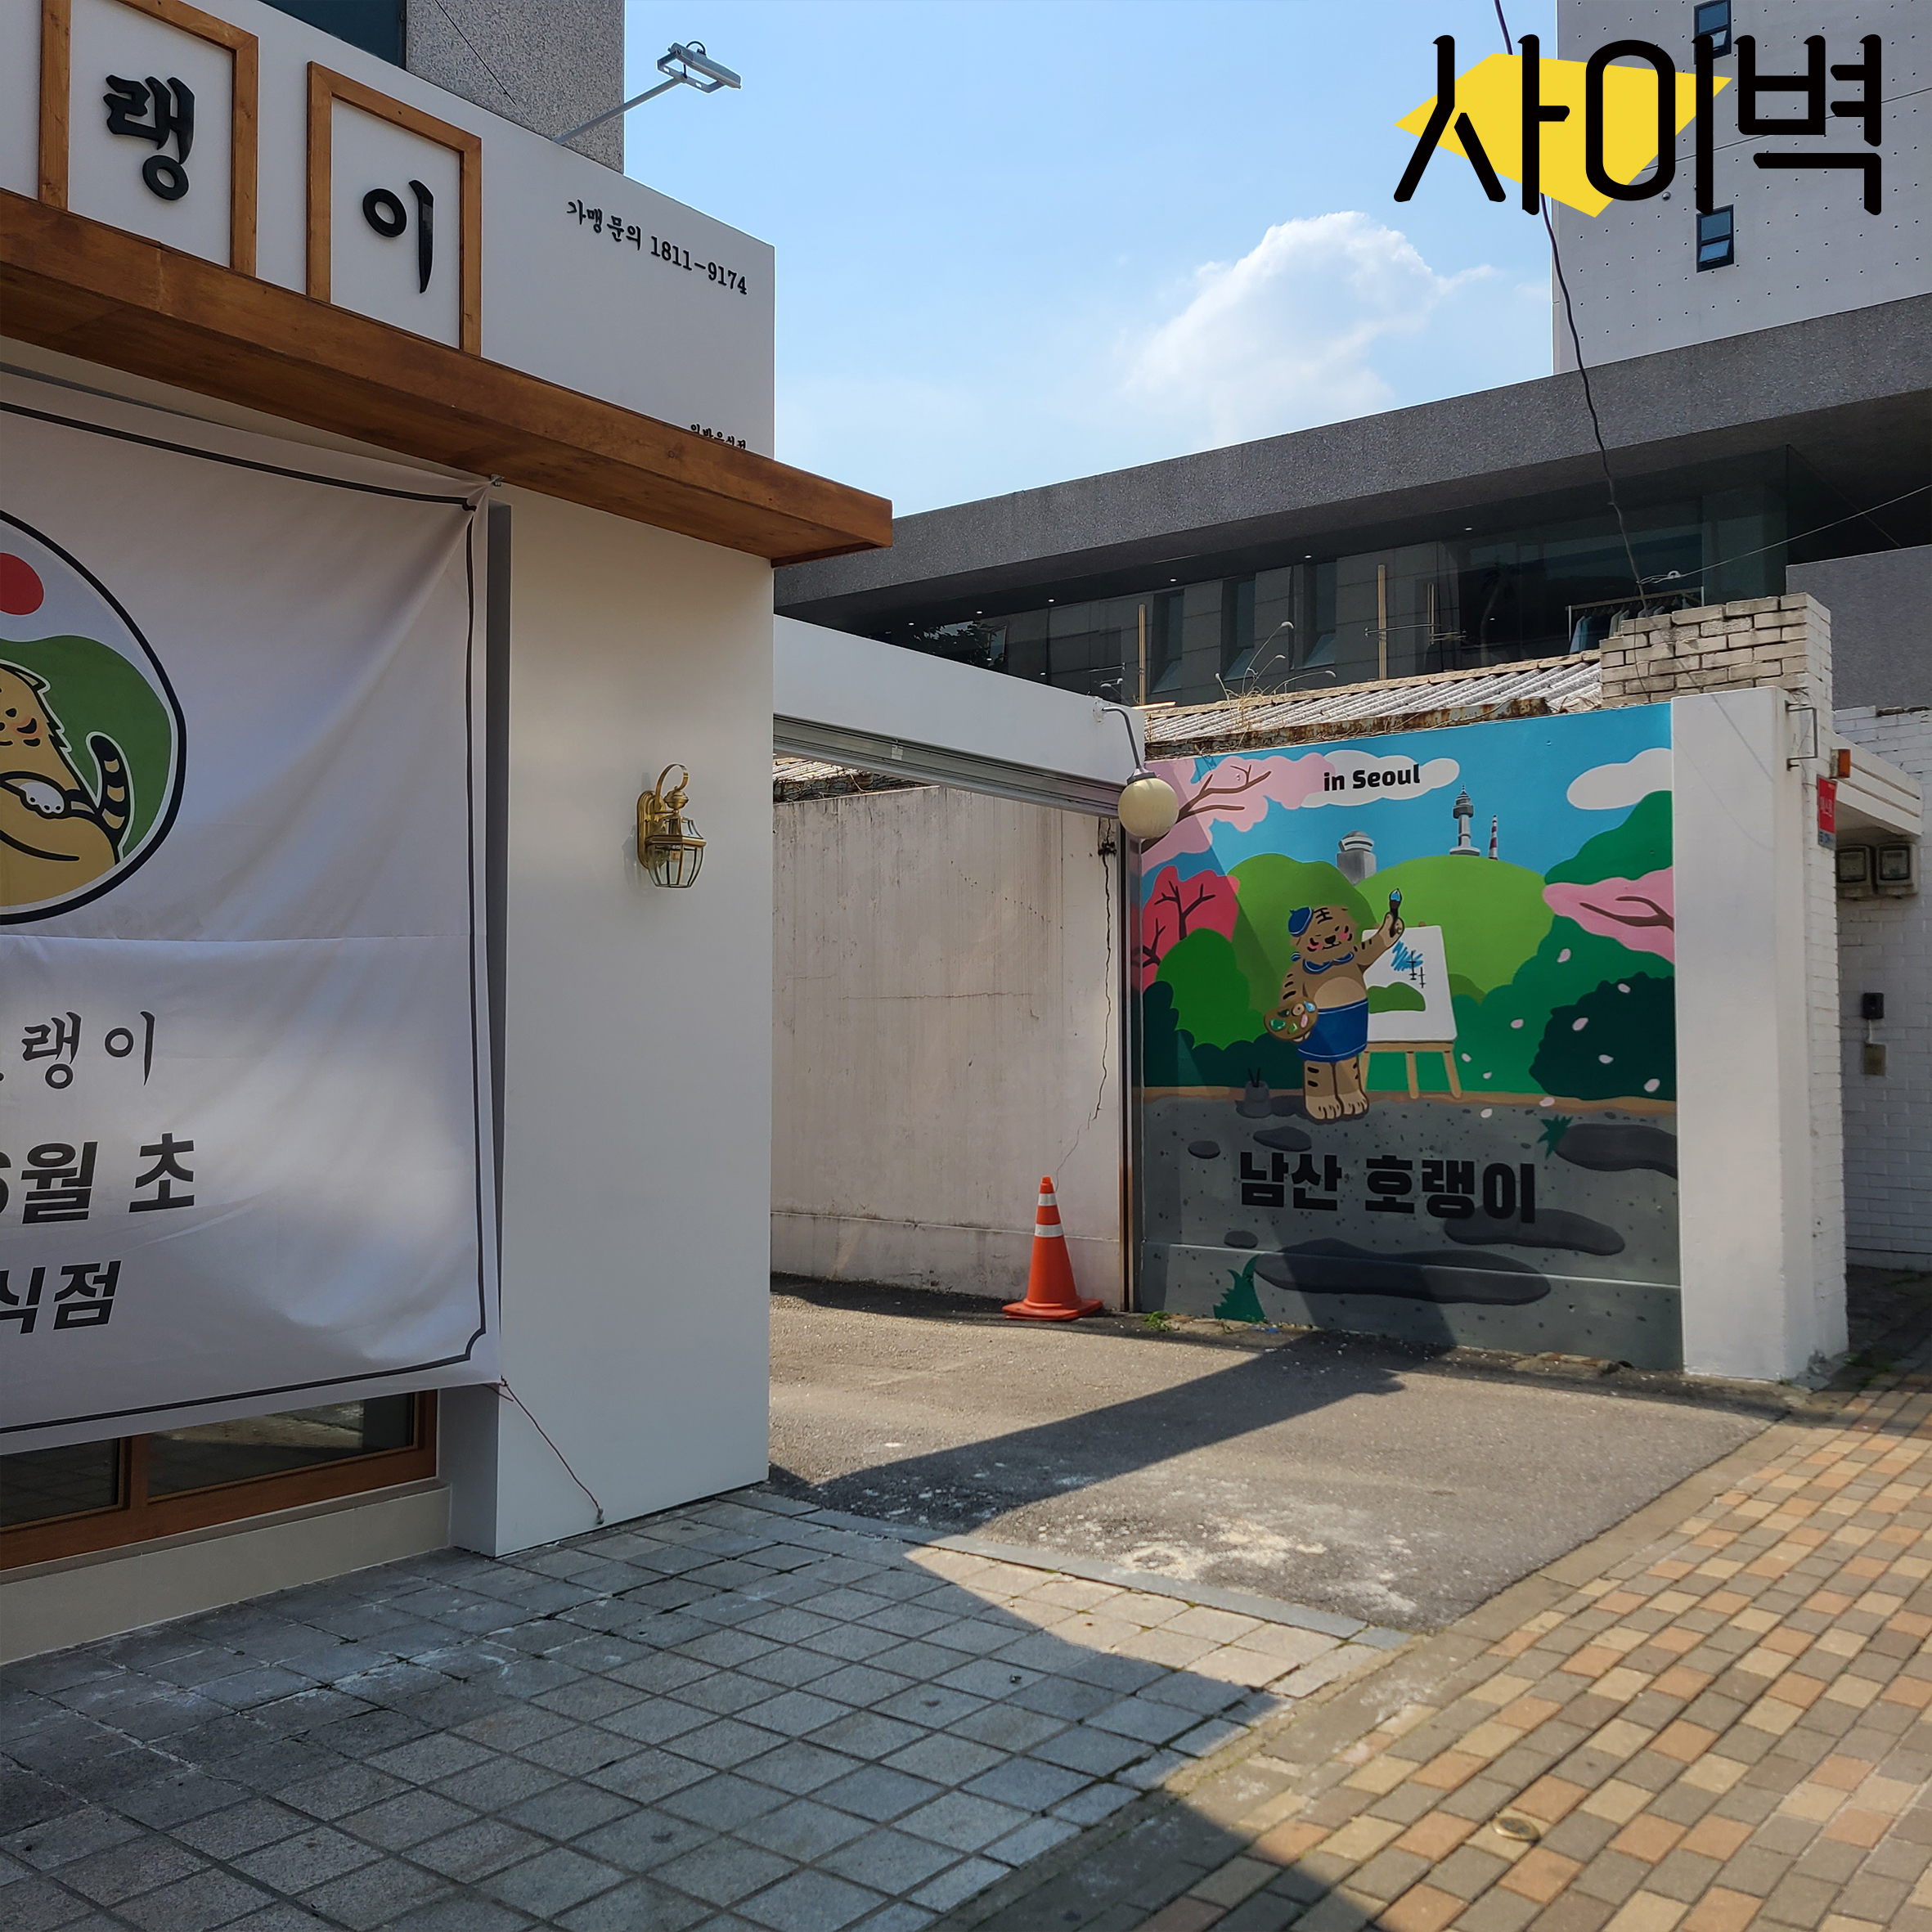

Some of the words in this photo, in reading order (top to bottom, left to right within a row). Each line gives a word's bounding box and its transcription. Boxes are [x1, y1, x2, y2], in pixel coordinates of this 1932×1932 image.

[567, 200, 603, 233] 가맹
[607, 215, 641, 250] 문의
[651, 236, 748, 295] 1811-9174
[1323, 771, 1345, 792] in
[1352, 763, 1420, 789] Seoul
[0, 1011, 155, 1090] 랭이
[128, 1132, 195, 1214] 초
[1240, 1152, 1342, 1211] 남산
[1364, 1154, 1536, 1224] 호랭이
